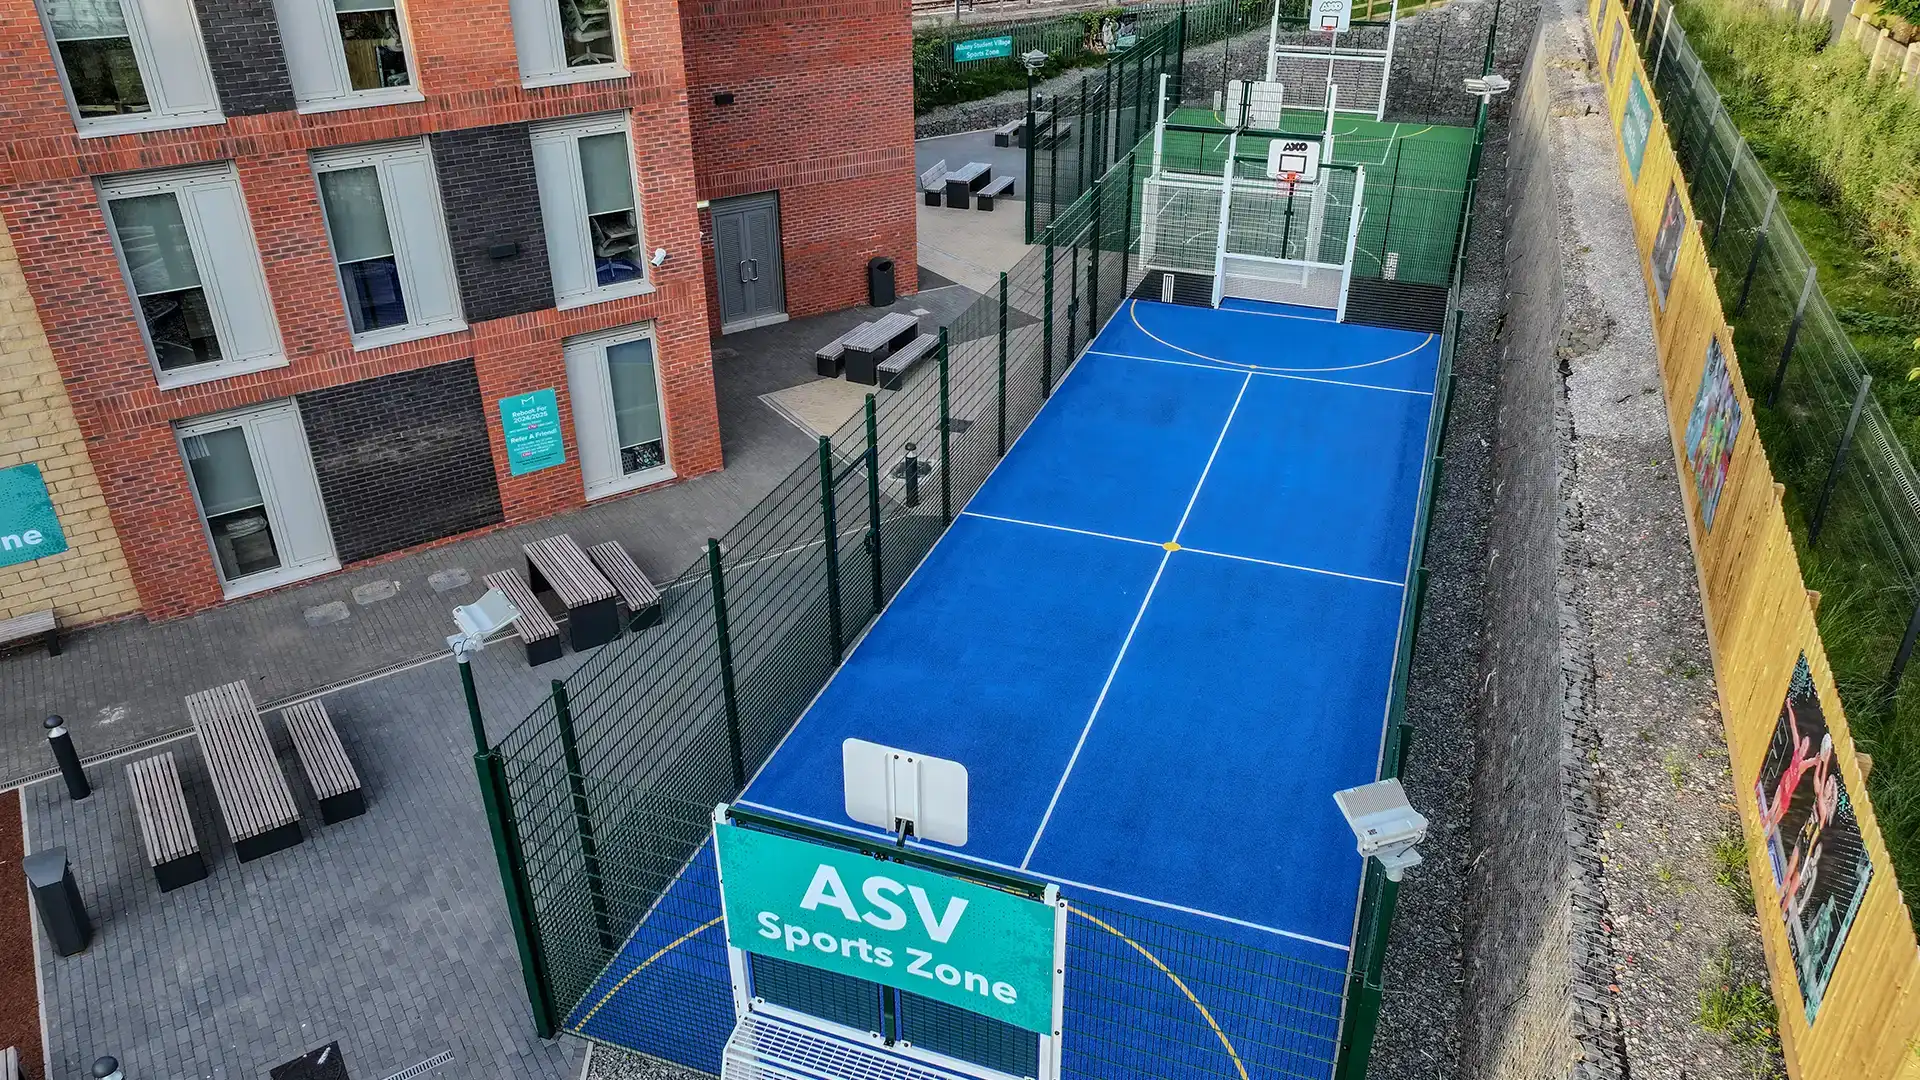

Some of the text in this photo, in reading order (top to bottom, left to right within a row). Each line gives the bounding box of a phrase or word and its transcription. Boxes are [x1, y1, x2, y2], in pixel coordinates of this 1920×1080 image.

[966, 51, 984, 59] Sports
[512, 408, 535, 417] Rebook
[513, 411, 548, 423] 2024/2025
[511, 435, 528, 443] Refer
[536, 428, 557, 437] Friend!
[0, 529, 43, 551] ne
[799, 863, 969, 944] ASV
[757, 911, 1018, 1005] Sports Zone
